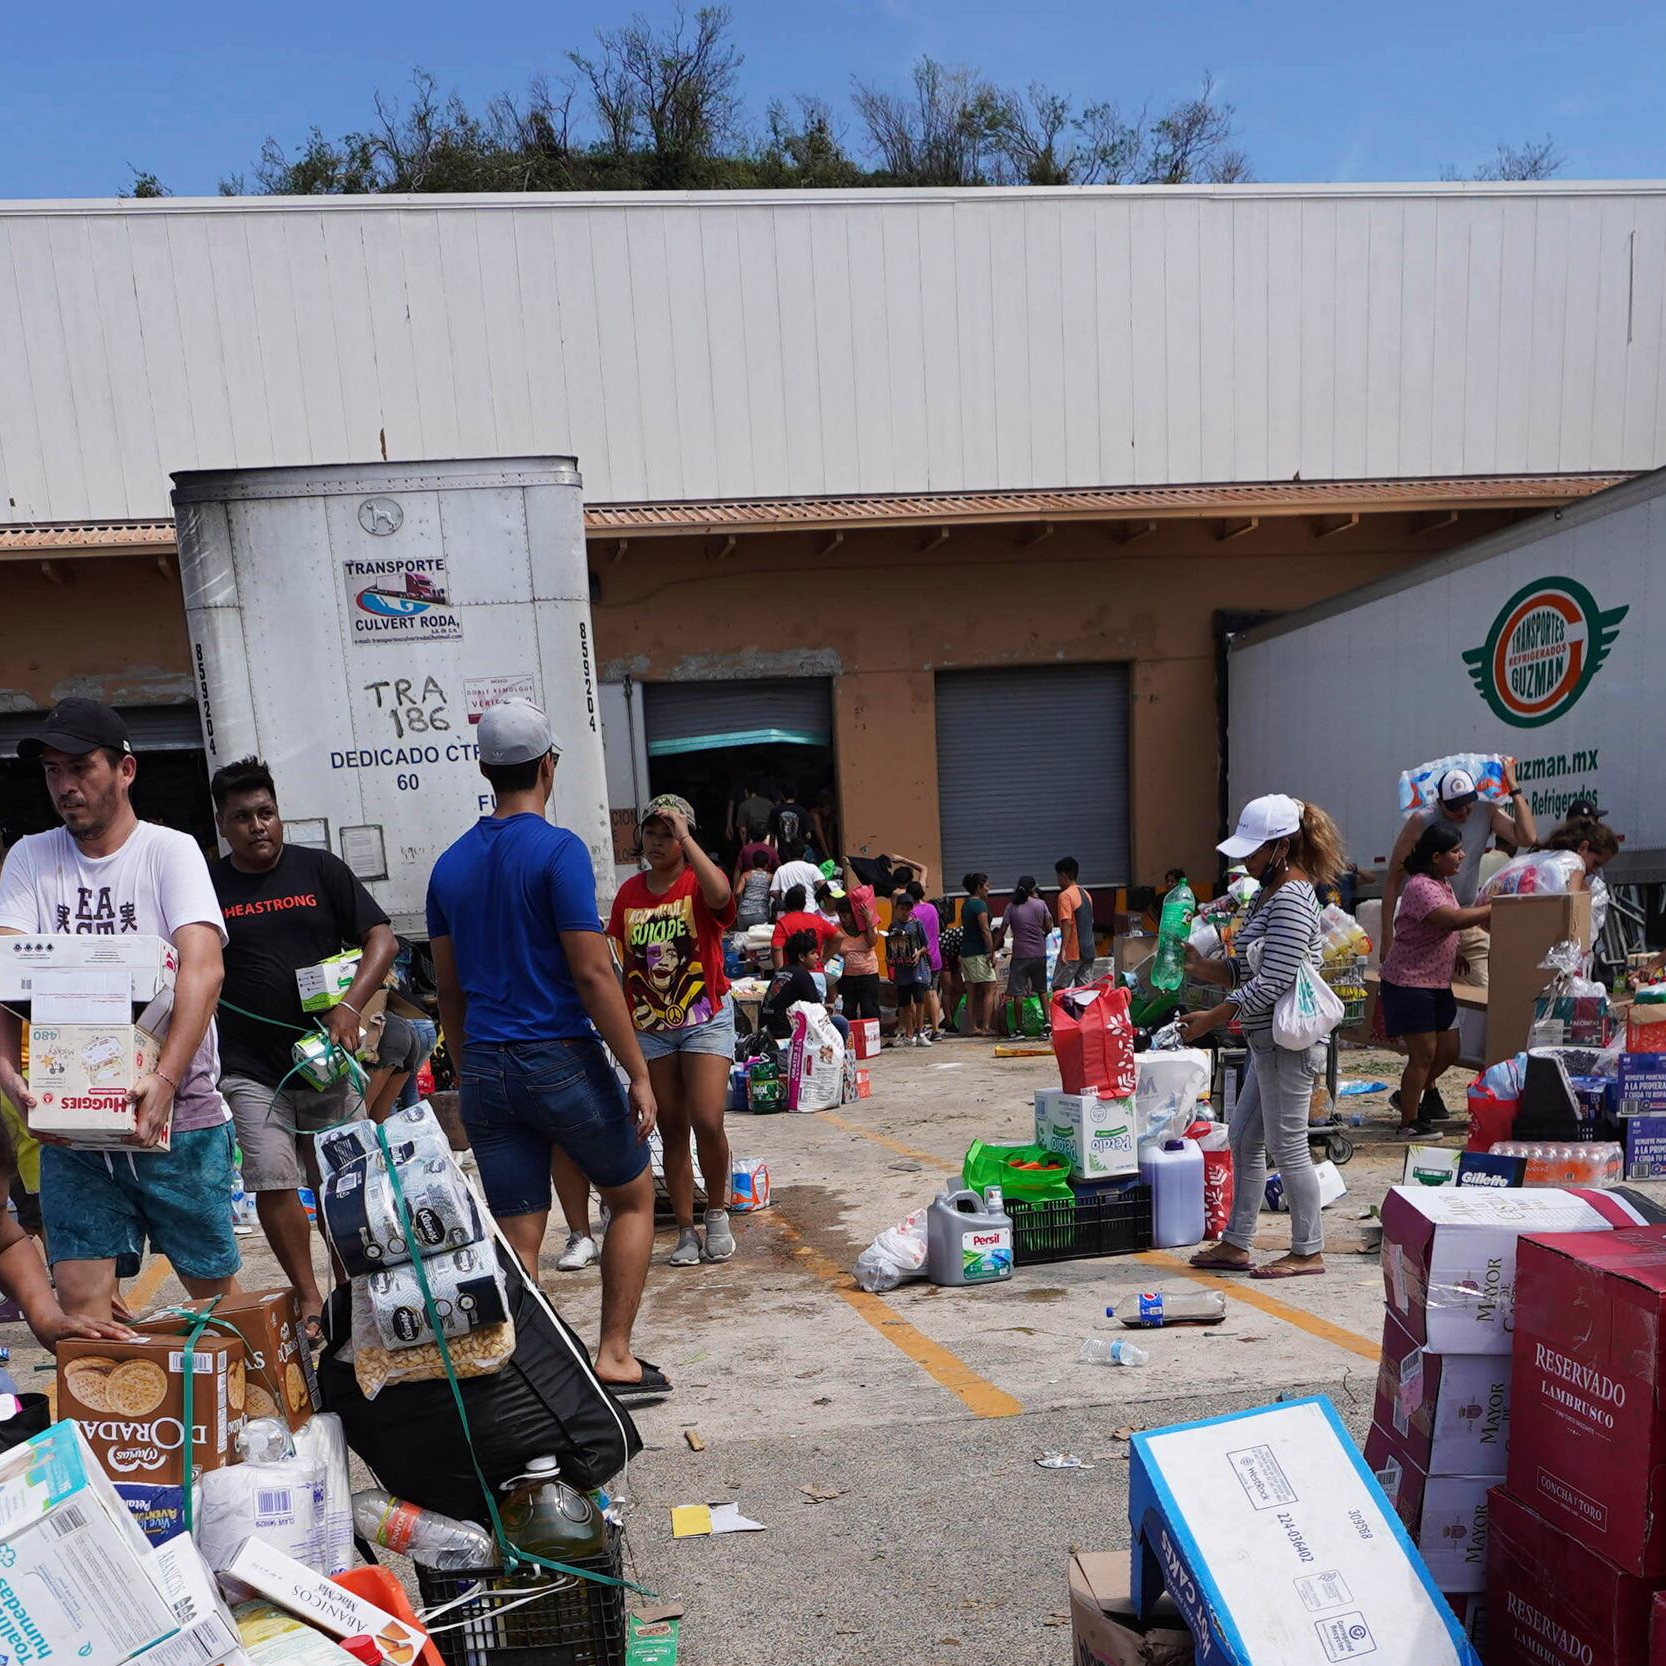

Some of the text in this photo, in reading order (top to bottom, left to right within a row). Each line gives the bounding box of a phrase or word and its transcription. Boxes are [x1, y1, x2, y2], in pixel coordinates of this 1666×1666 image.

[345, 559, 444, 575] TRANSPORTE
[356, 617, 415, 631] CULVERT
[1511, 612, 1565, 653] TRANSPORTES
[1509, 643, 1567, 668] REFRIGERADOS
[365, 675, 447, 708] TRA
[1511, 663, 1563, 699] GUZMAN
[389, 707, 450, 738] 186
[331, 746, 439, 769] DEDICADO
[397, 773, 419, 790] 60
[631, 918, 686, 945] SUICIDE
[61, 1097, 127, 1113] HUGGIES
[1462, 1171, 1508, 1187] Gillette
[416, 1207, 440, 1244] Kleenex
[973, 1232, 1000, 1246] Persil
[1476, 1256, 1503, 1323] MAYOR
[1534, 1342, 1626, 1409] RESERVADO
[1480, 1381, 1505, 1445] MAYOR
[1540, 1380, 1614, 1430] LAMBRUSCO
[1247, 1467, 1271, 1501] WestRock
[1277, 1512, 1314, 1563] 224-036402
[1161, 1529, 1196, 1604] CAKES
[291, 1585, 368, 1632] ABANICOS
[1195, 1606, 1211, 1660] HOT
